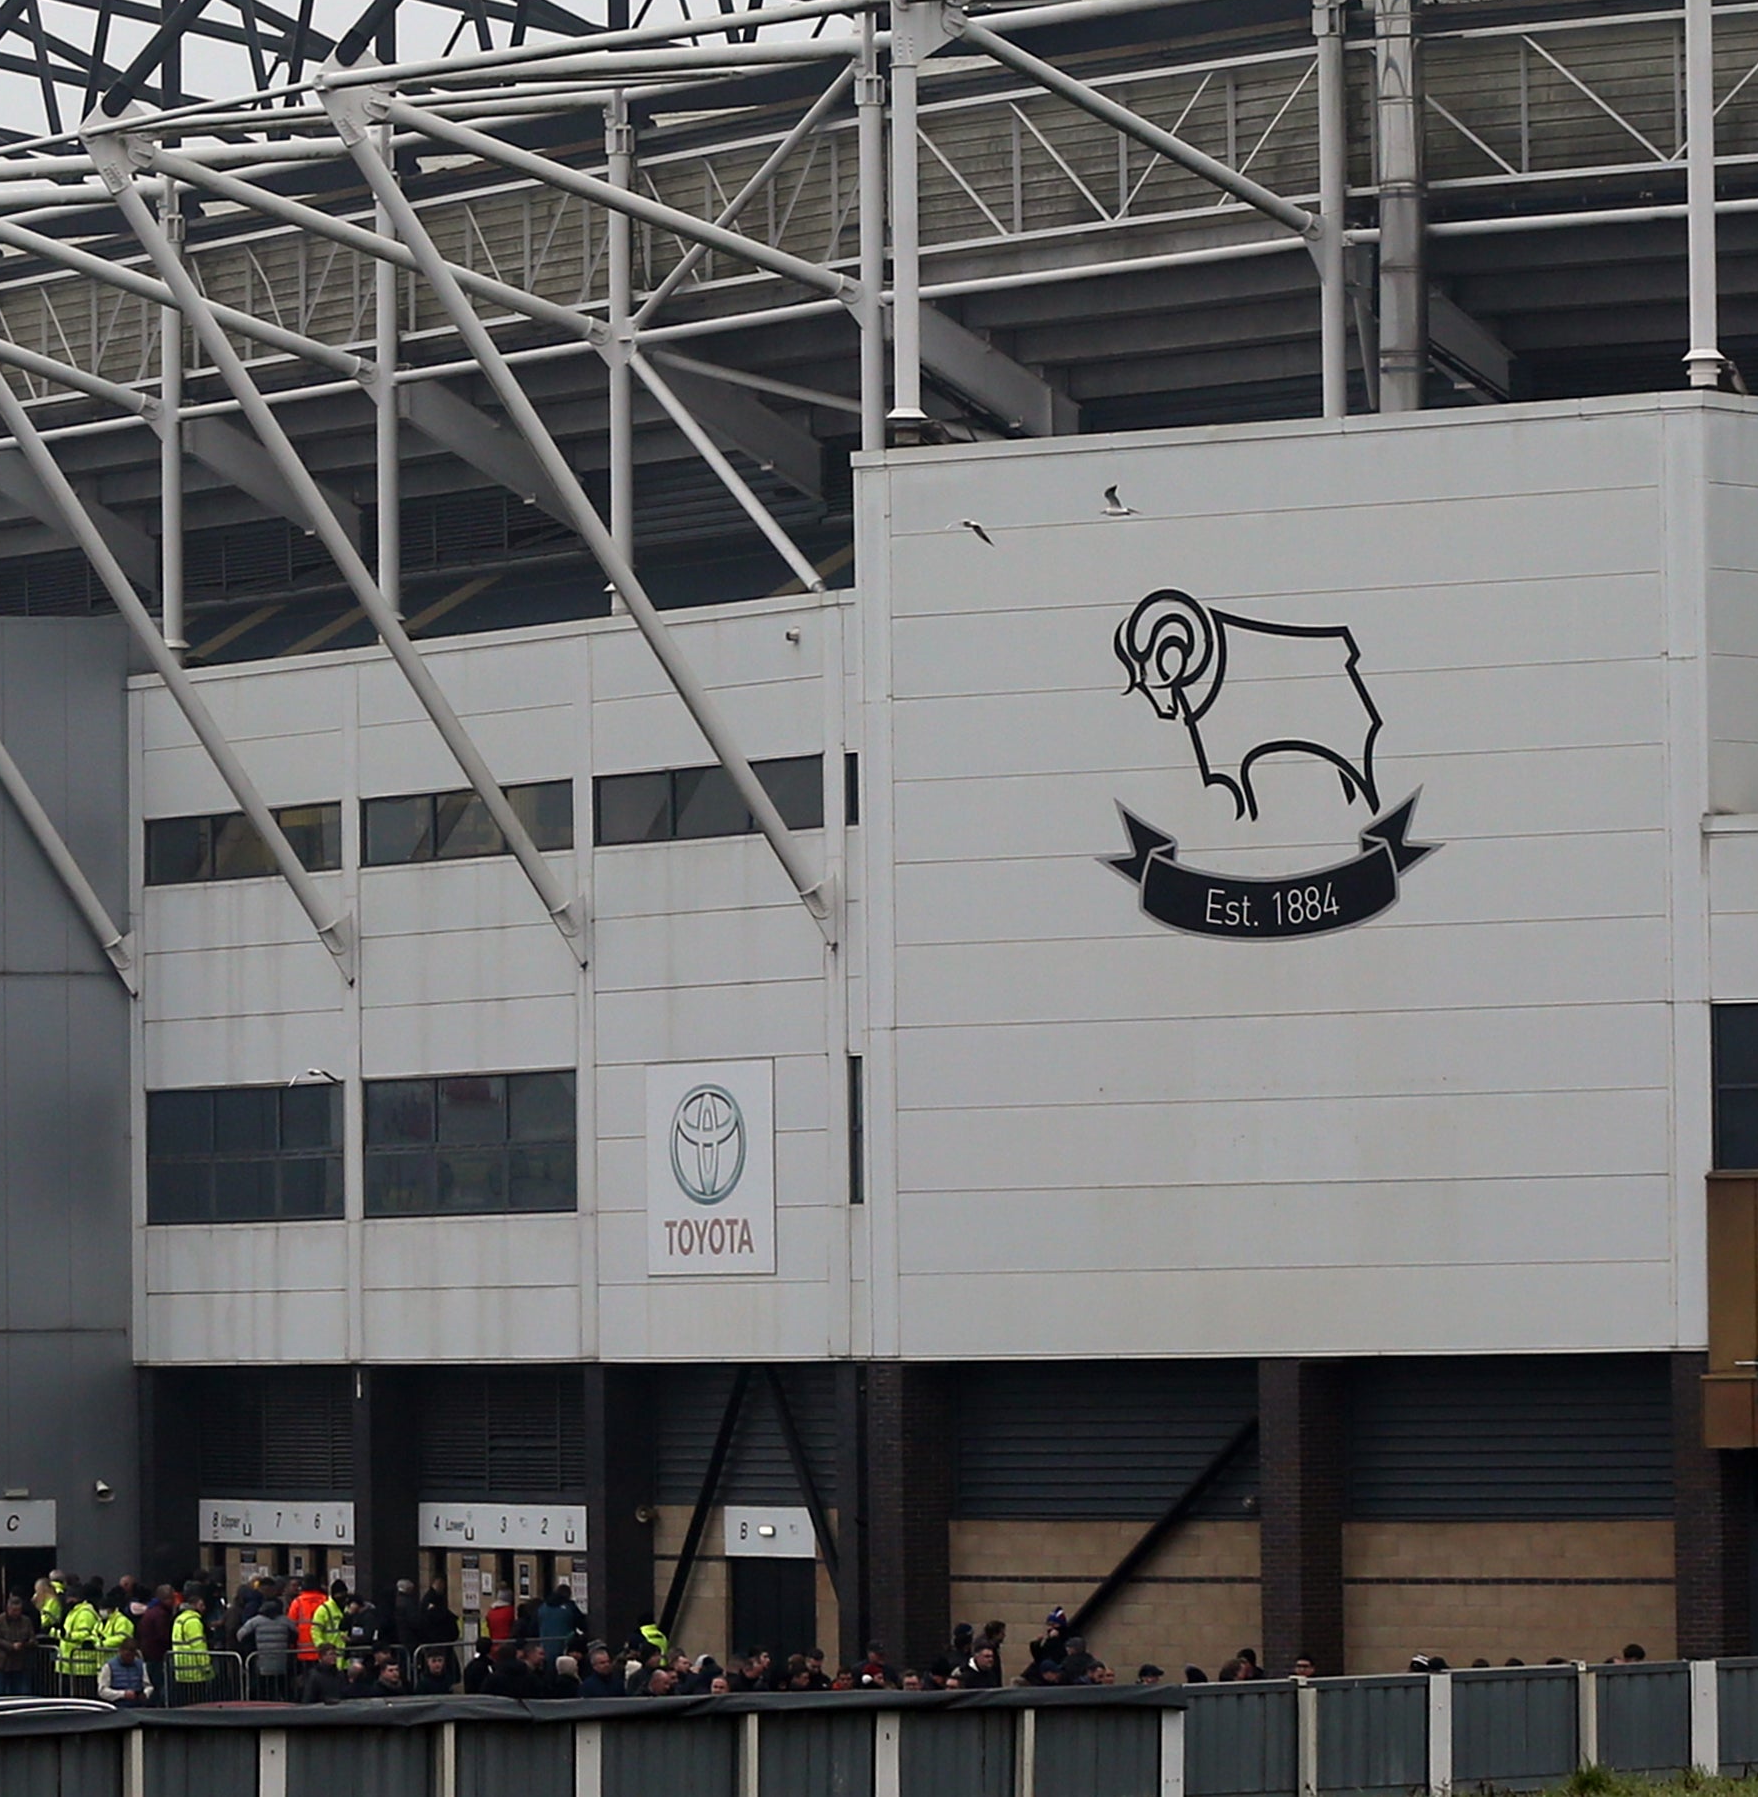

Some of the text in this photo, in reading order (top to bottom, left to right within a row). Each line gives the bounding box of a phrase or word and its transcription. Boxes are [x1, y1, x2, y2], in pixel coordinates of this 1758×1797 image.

[1205, 882, 1340, 927] Est. 1884
[664, 1218, 754, 1256] TOYOTA
[6, 1514, 20, 1532] C
[275, 1511, 282, 1528] 7
[314, 1513, 321, 1529] 6
[434, 1515, 440, 1531] 4
[501, 1516, 507, 1534] 3
[541, 1517, 549, 1535] 2
